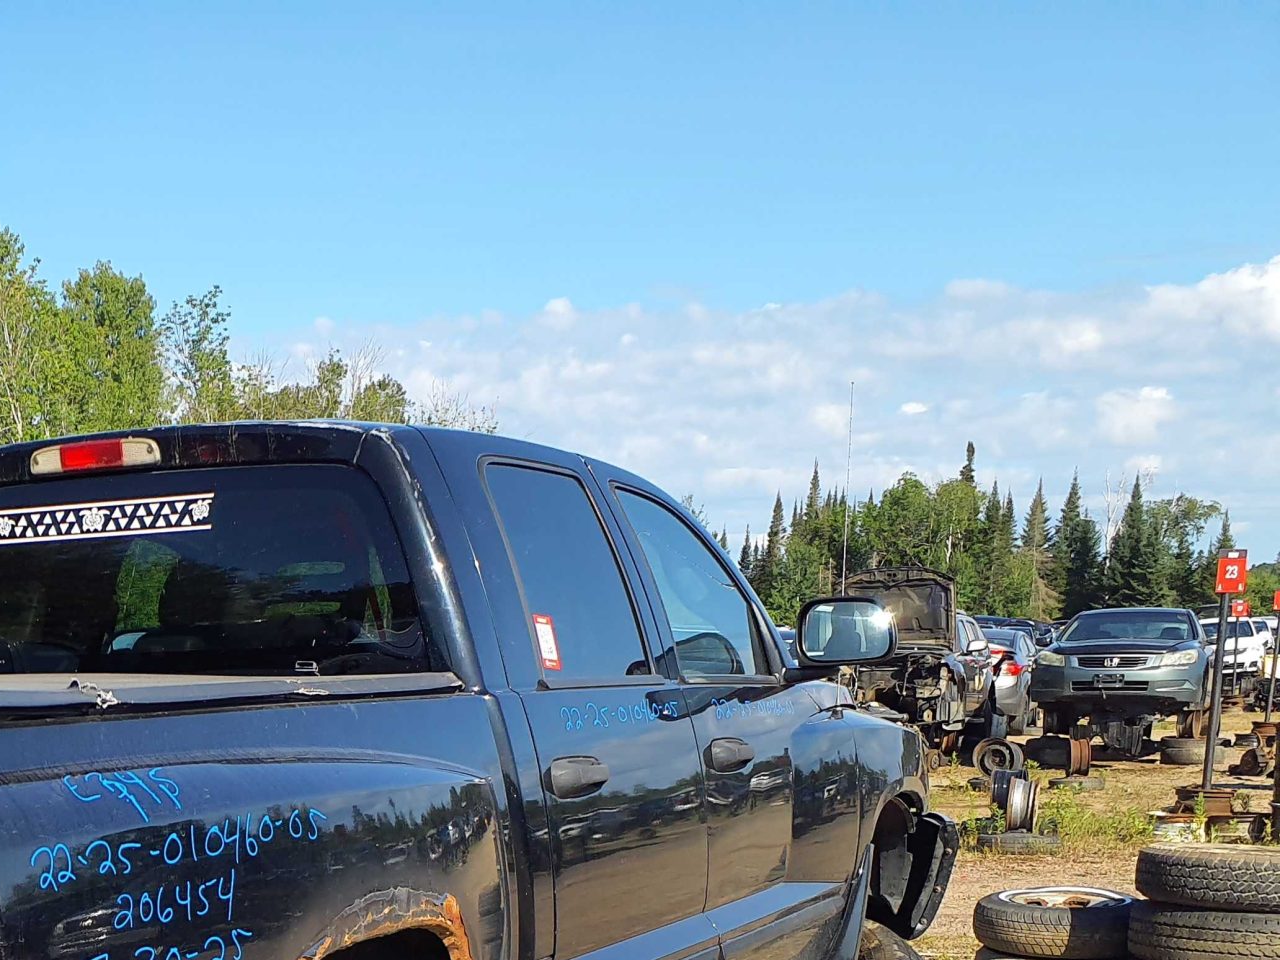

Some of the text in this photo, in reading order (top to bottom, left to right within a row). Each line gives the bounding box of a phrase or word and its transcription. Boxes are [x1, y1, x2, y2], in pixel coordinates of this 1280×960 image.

[1224, 564, 1239, 579] 23
[30, 808, 328, 892] 22-25-010460-05
[113, 868, 236, 929] 206454
